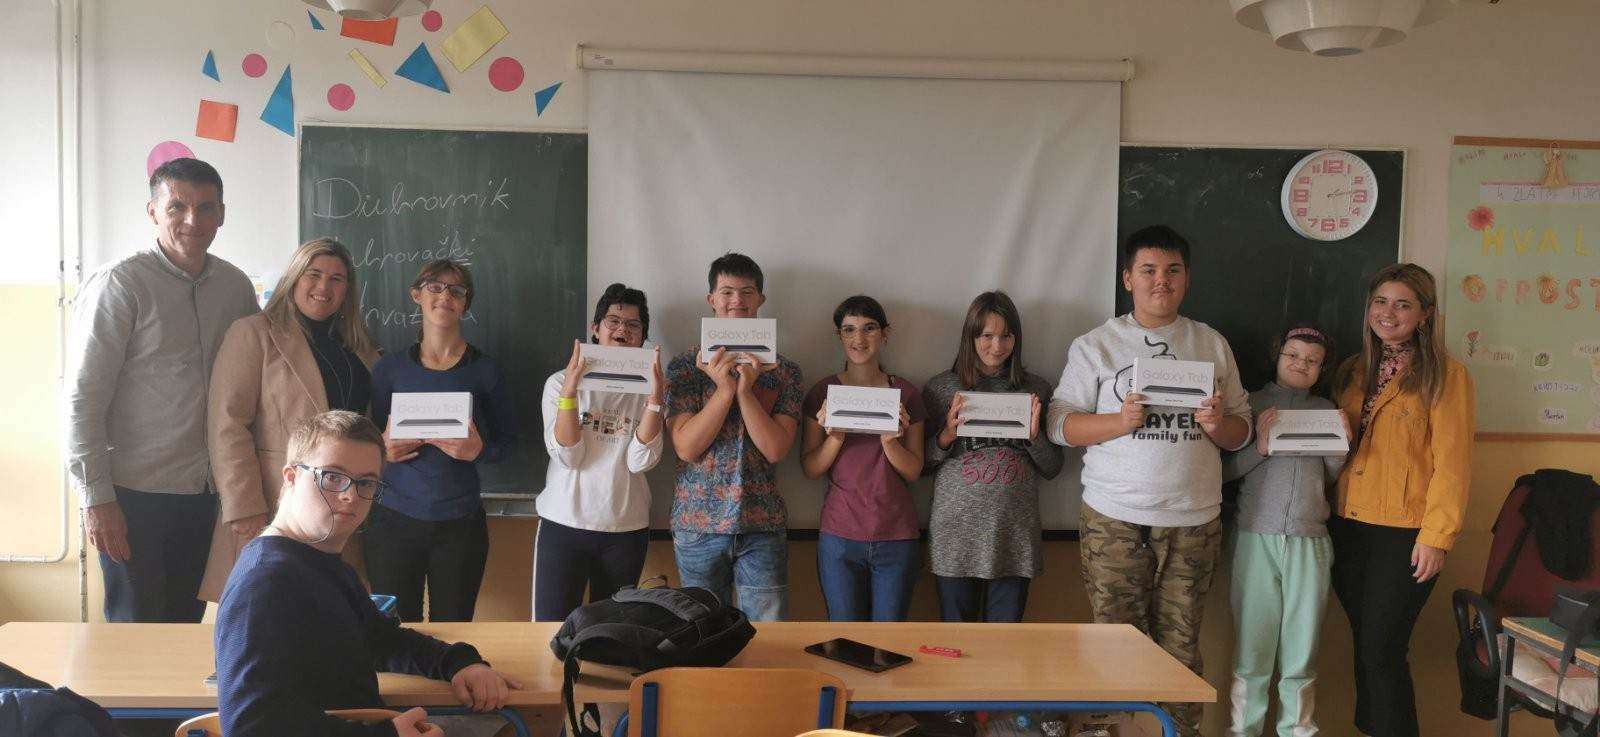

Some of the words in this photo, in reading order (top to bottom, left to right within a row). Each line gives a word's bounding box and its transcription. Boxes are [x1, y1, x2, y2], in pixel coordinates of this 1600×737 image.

[313, 177, 512, 219] Dubrovnik
[1353, 189, 1368, 203] 3
[351, 230, 474, 272] ubrovački
[1132, 430, 1178, 444] family
[1183, 431, 1202, 441] fun
